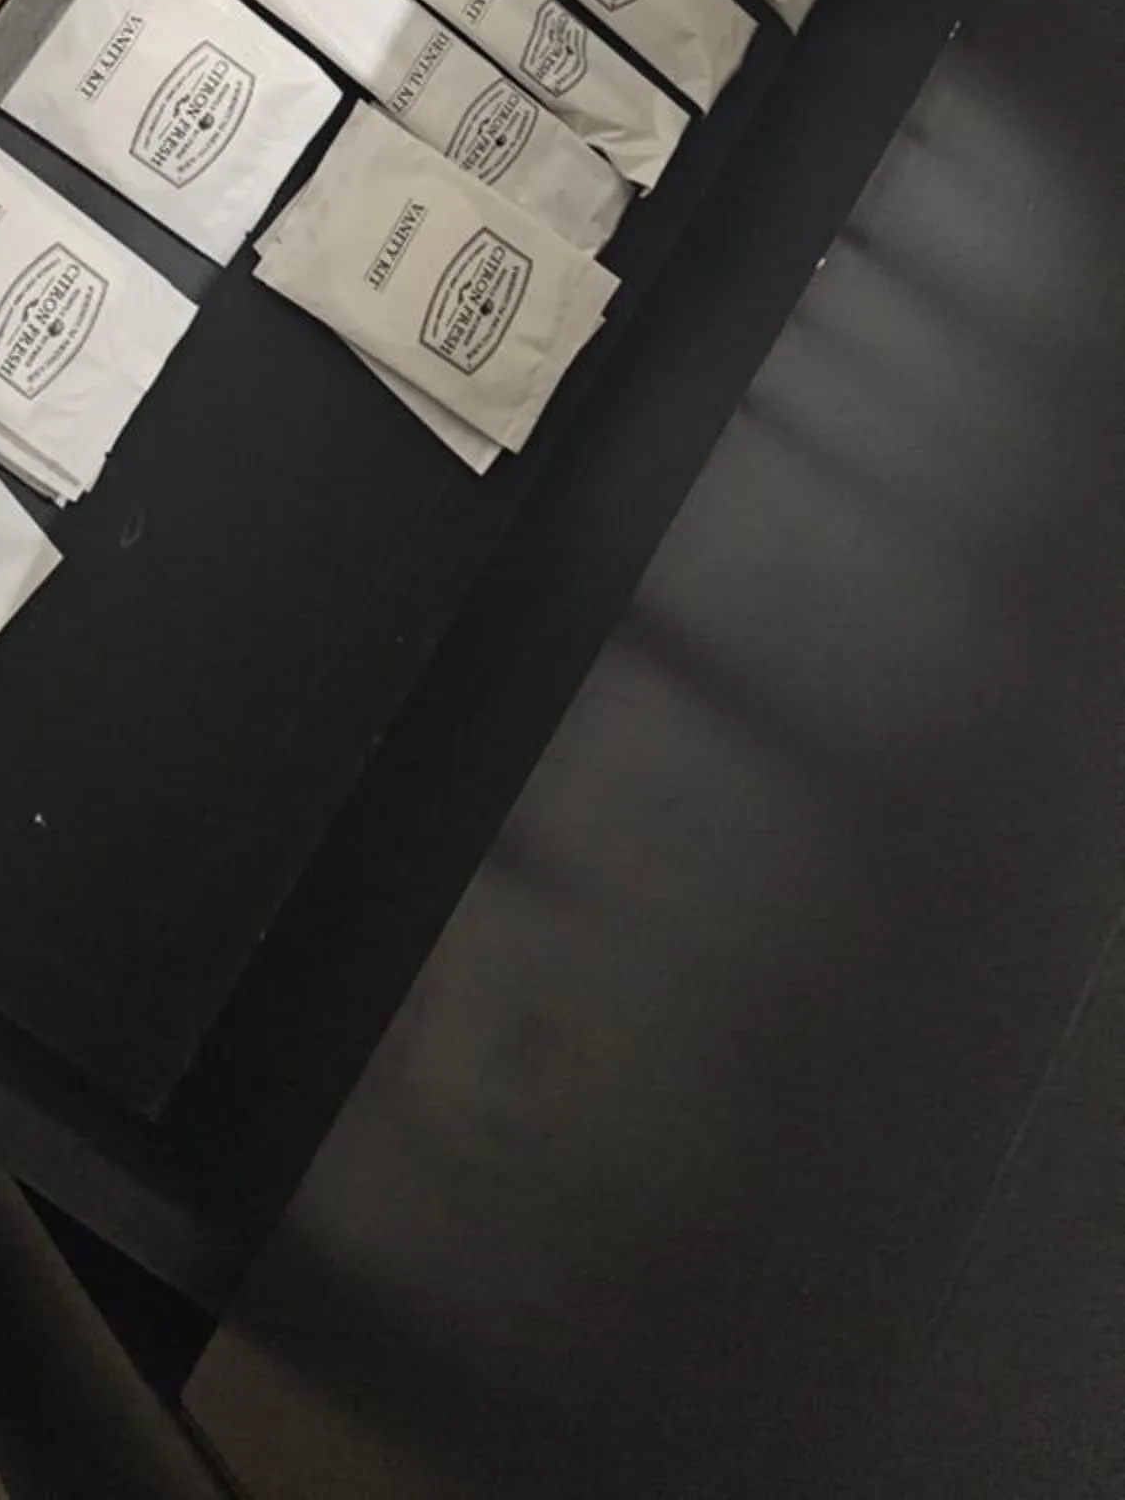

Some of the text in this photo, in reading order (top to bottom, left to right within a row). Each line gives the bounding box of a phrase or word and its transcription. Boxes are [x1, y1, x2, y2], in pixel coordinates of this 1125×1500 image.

[80, 13, 143, 100] VANITY KIT
[390, 31, 450, 114] DENTAL KIT
[183, 58, 231, 119] CITRON
[150, 117, 191, 167] FRESH
[366, 201, 424, 290] VANITY KIT
[467, 244, 507, 305] CITRON
[32, 261, 82, 325] CITRON
[438, 304, 475, 356] FRESH
